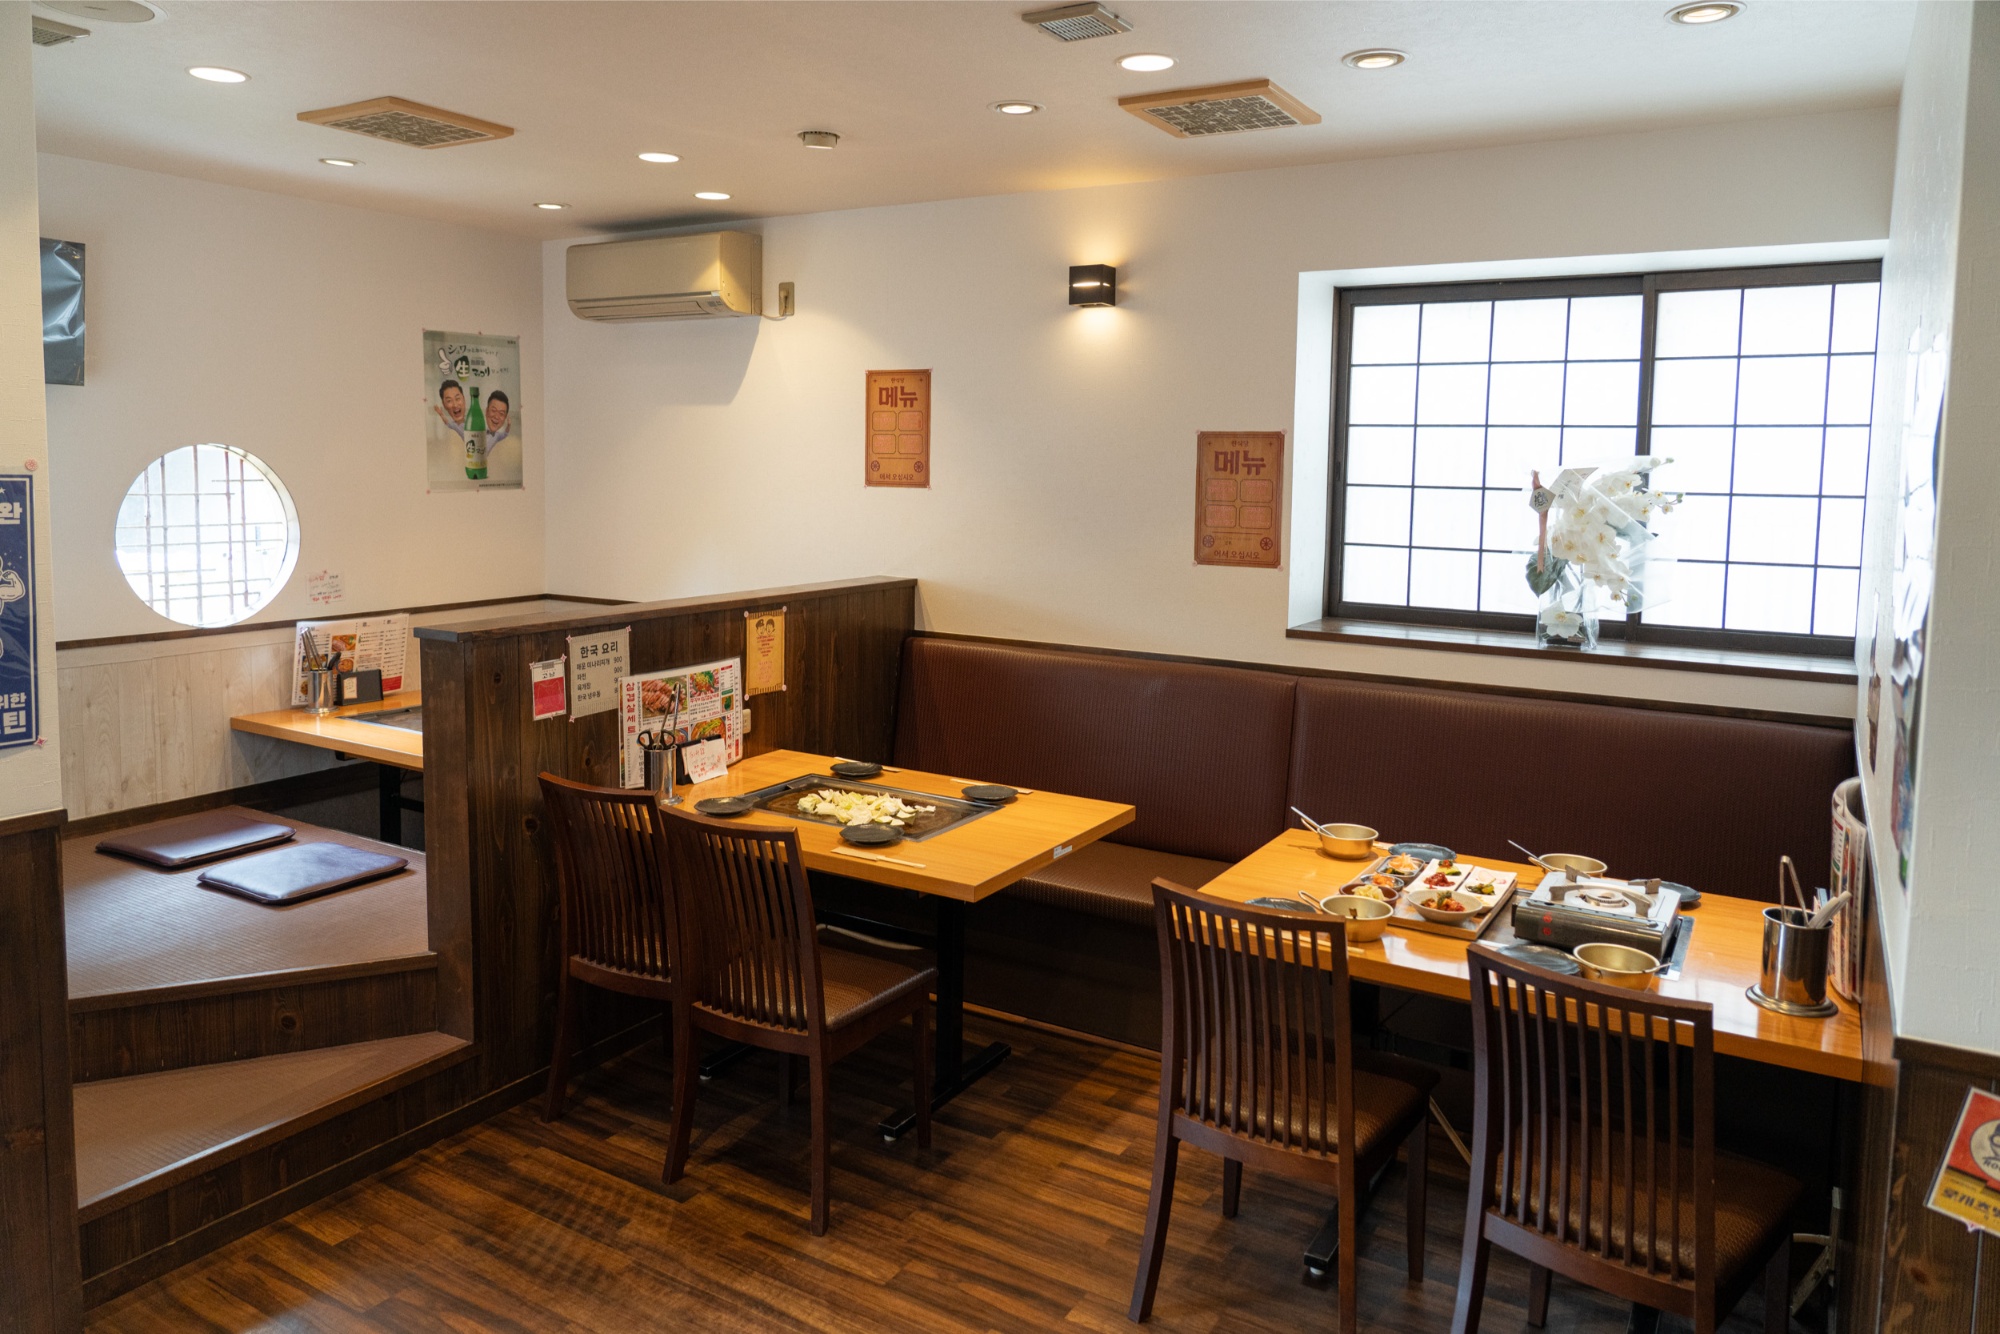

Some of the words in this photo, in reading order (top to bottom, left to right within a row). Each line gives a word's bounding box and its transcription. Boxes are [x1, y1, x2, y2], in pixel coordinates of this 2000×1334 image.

[879, 386, 918, 408] 메뉴
[1214, 450, 1266, 475] 메뉴
[580, 644, 598, 659] 한국
[601, 640, 618, 654] 요리
[613, 656, 623, 664] 900
[613, 666, 623, 674] 900
[0, 709, 27, 735] 틴
[1983, 1160, 2000, 1172] RO
